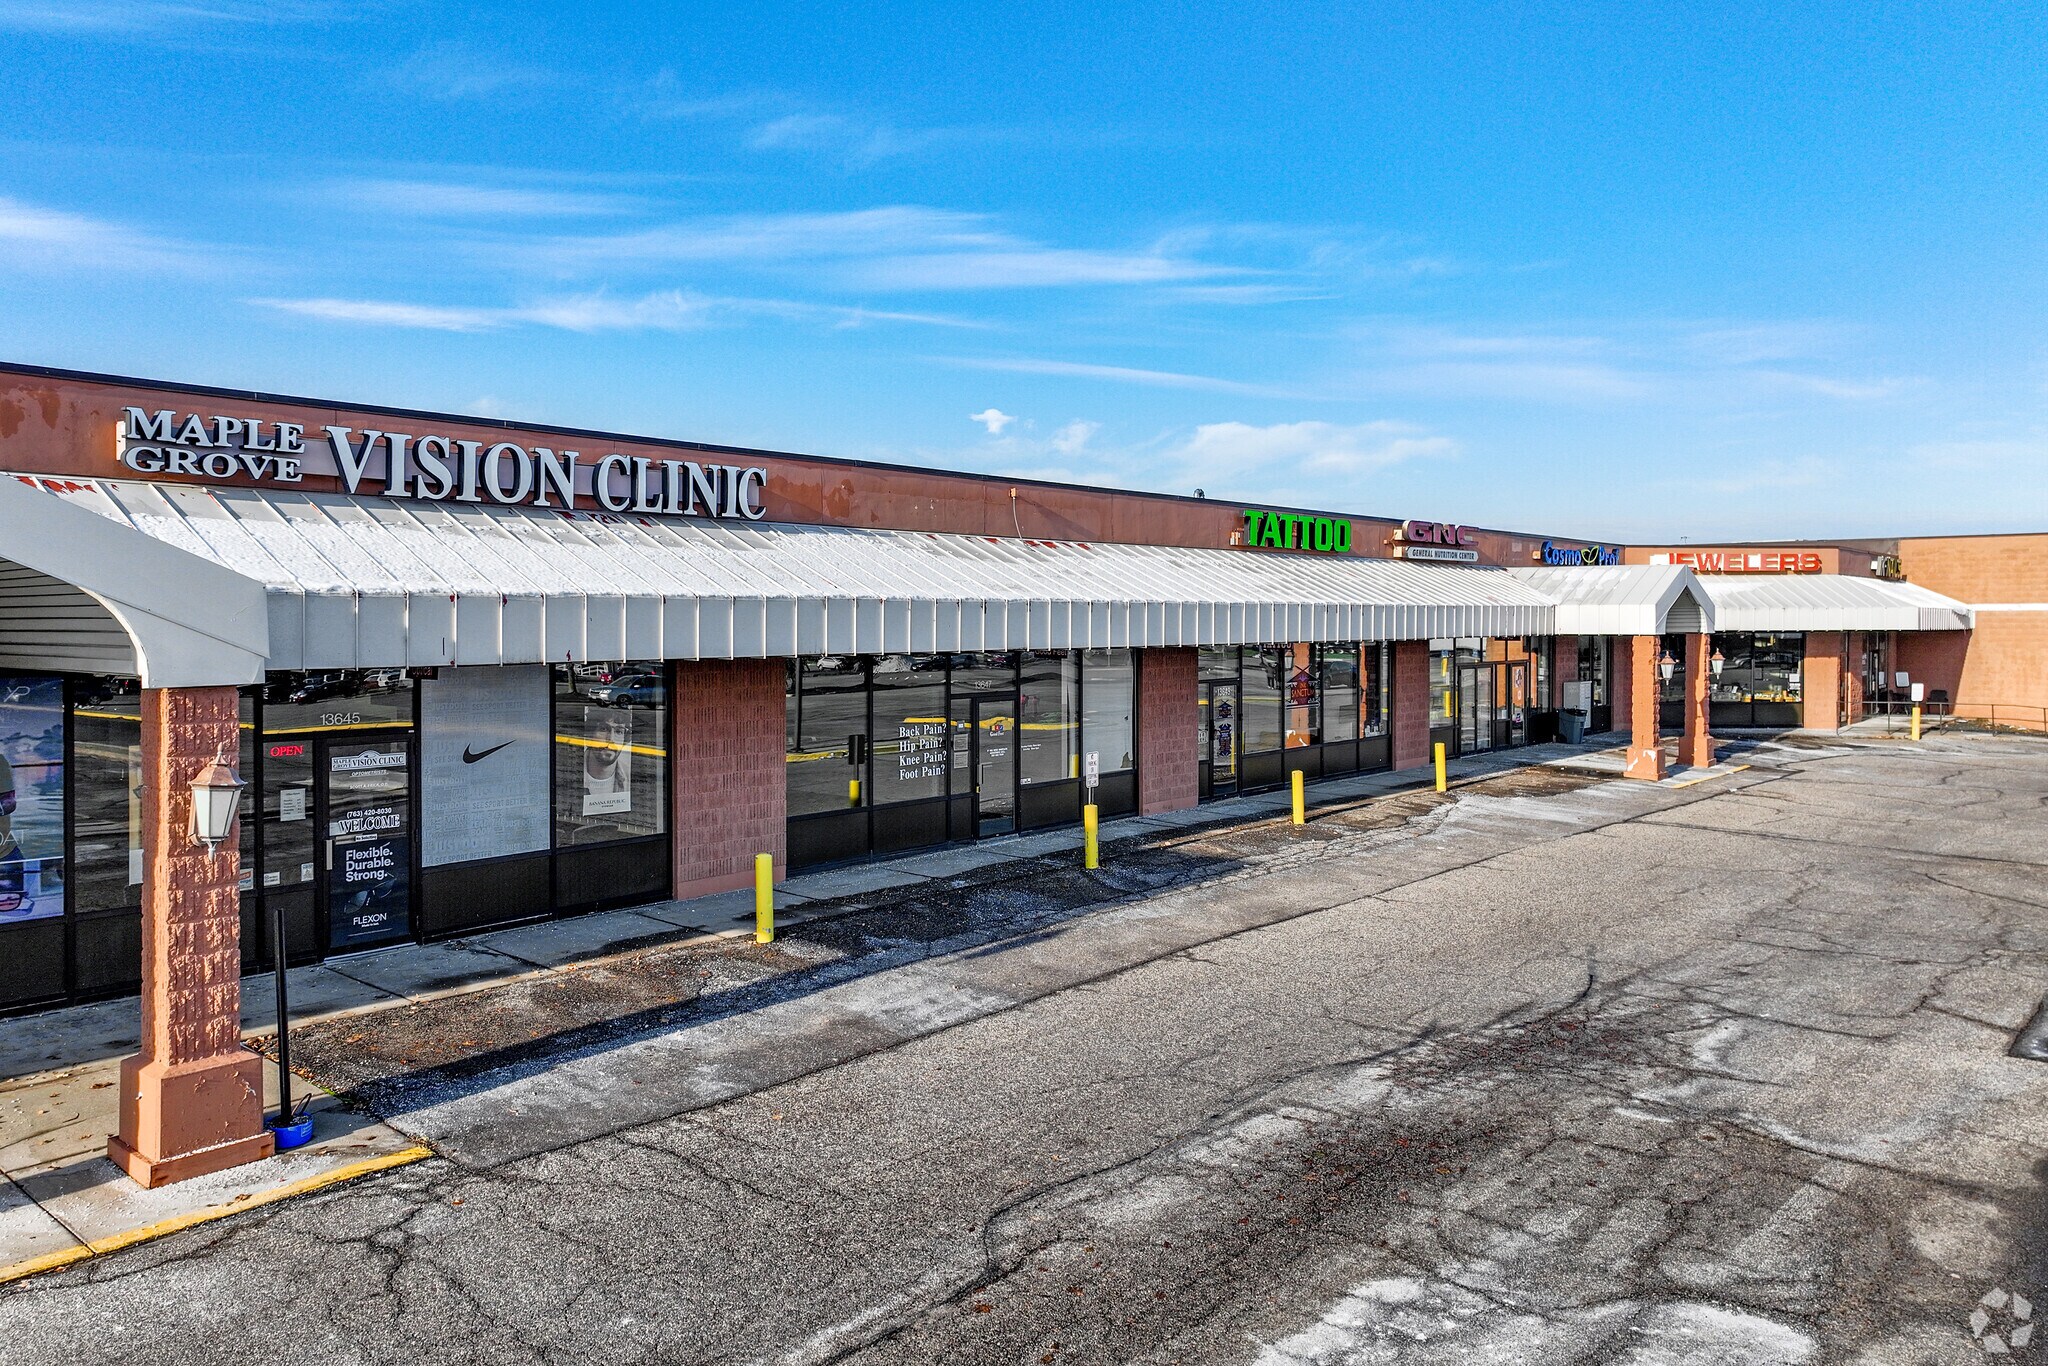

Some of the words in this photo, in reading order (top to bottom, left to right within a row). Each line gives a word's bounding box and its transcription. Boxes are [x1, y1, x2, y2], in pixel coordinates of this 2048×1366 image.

[124, 406, 305, 454] MAPLE
[122, 447, 304, 482] GROVE
[322, 425, 580, 510] VISION
[593, 454, 767, 520] CLINIC
[1244, 509, 1351, 552] TATTOO
[1404, 520, 1480, 546] GNC
[1412, 549, 1433, 557] GENERAL
[1434, 550, 1458, 559] NUTRITION
[1458, 552, 1475, 560] CENTER
[1541, 540, 1582, 566] Cosmo
[1599, 545, 1620, 566] Prof
[320, 712, 361, 726] 13645
[899, 726, 920, 738] Back
[923, 723, 947, 736] Pain?
[269, 744, 304, 757] OPEN
[900, 740, 916, 753] Hip
[919, 737, 943, 750] Pain?
[352, 758, 379, 766] VISION
[899, 755, 920, 767] Knee
[923, 750, 947, 763] Pain?
[899, 768, 918, 780] Foot
[921, 764, 946, 778] Pain?
[346, 811, 363, 819] (763)
[363, 807, 392, 816] 420-8030
[338, 814, 400, 833] WELCOME
[345, 846, 394, 861] Flexible.
[345, 857, 395, 872] Durable.
[345, 867, 388, 883] Strong.
[353, 912, 387, 926] FLEXON
